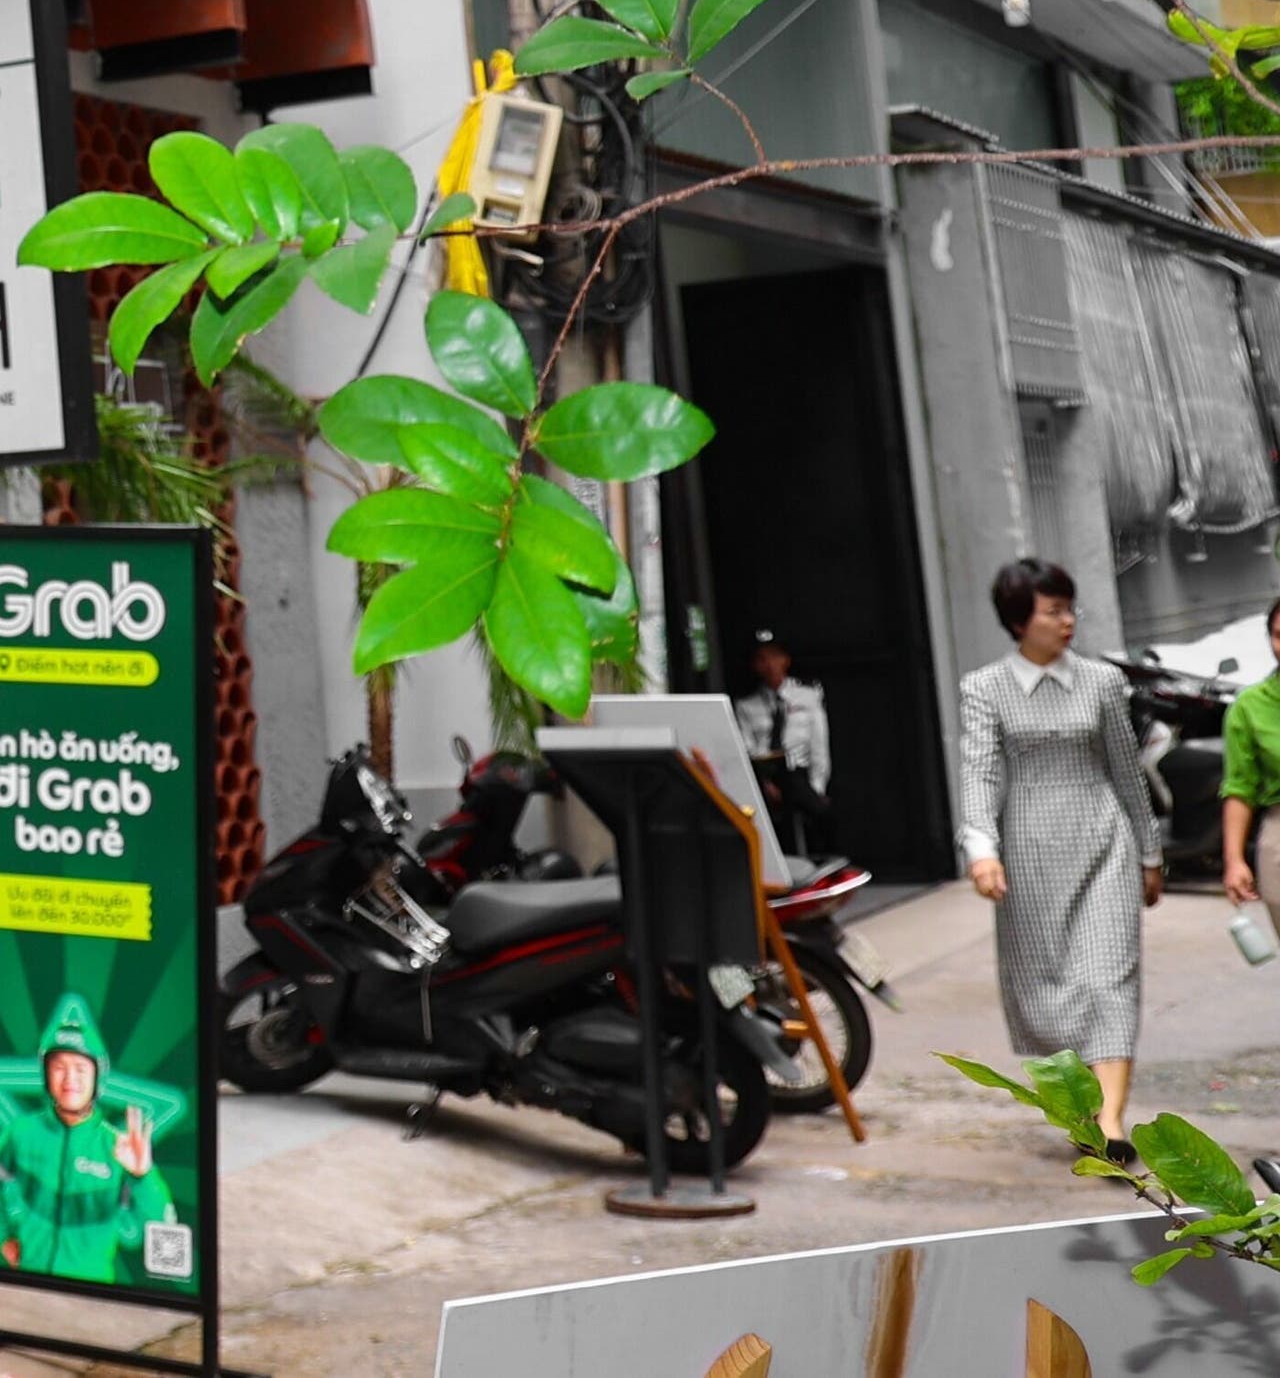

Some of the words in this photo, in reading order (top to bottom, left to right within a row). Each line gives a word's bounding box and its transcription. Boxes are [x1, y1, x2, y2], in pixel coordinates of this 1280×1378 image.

[20, 728, 56, 760] hò
[60, 728, 98, 762] ăn
[99, 730, 180, 773] uống,
[37, 767, 152, 816] Grab
[15, 815, 85, 855] bao
[86, 819, 125, 858] rẻ
